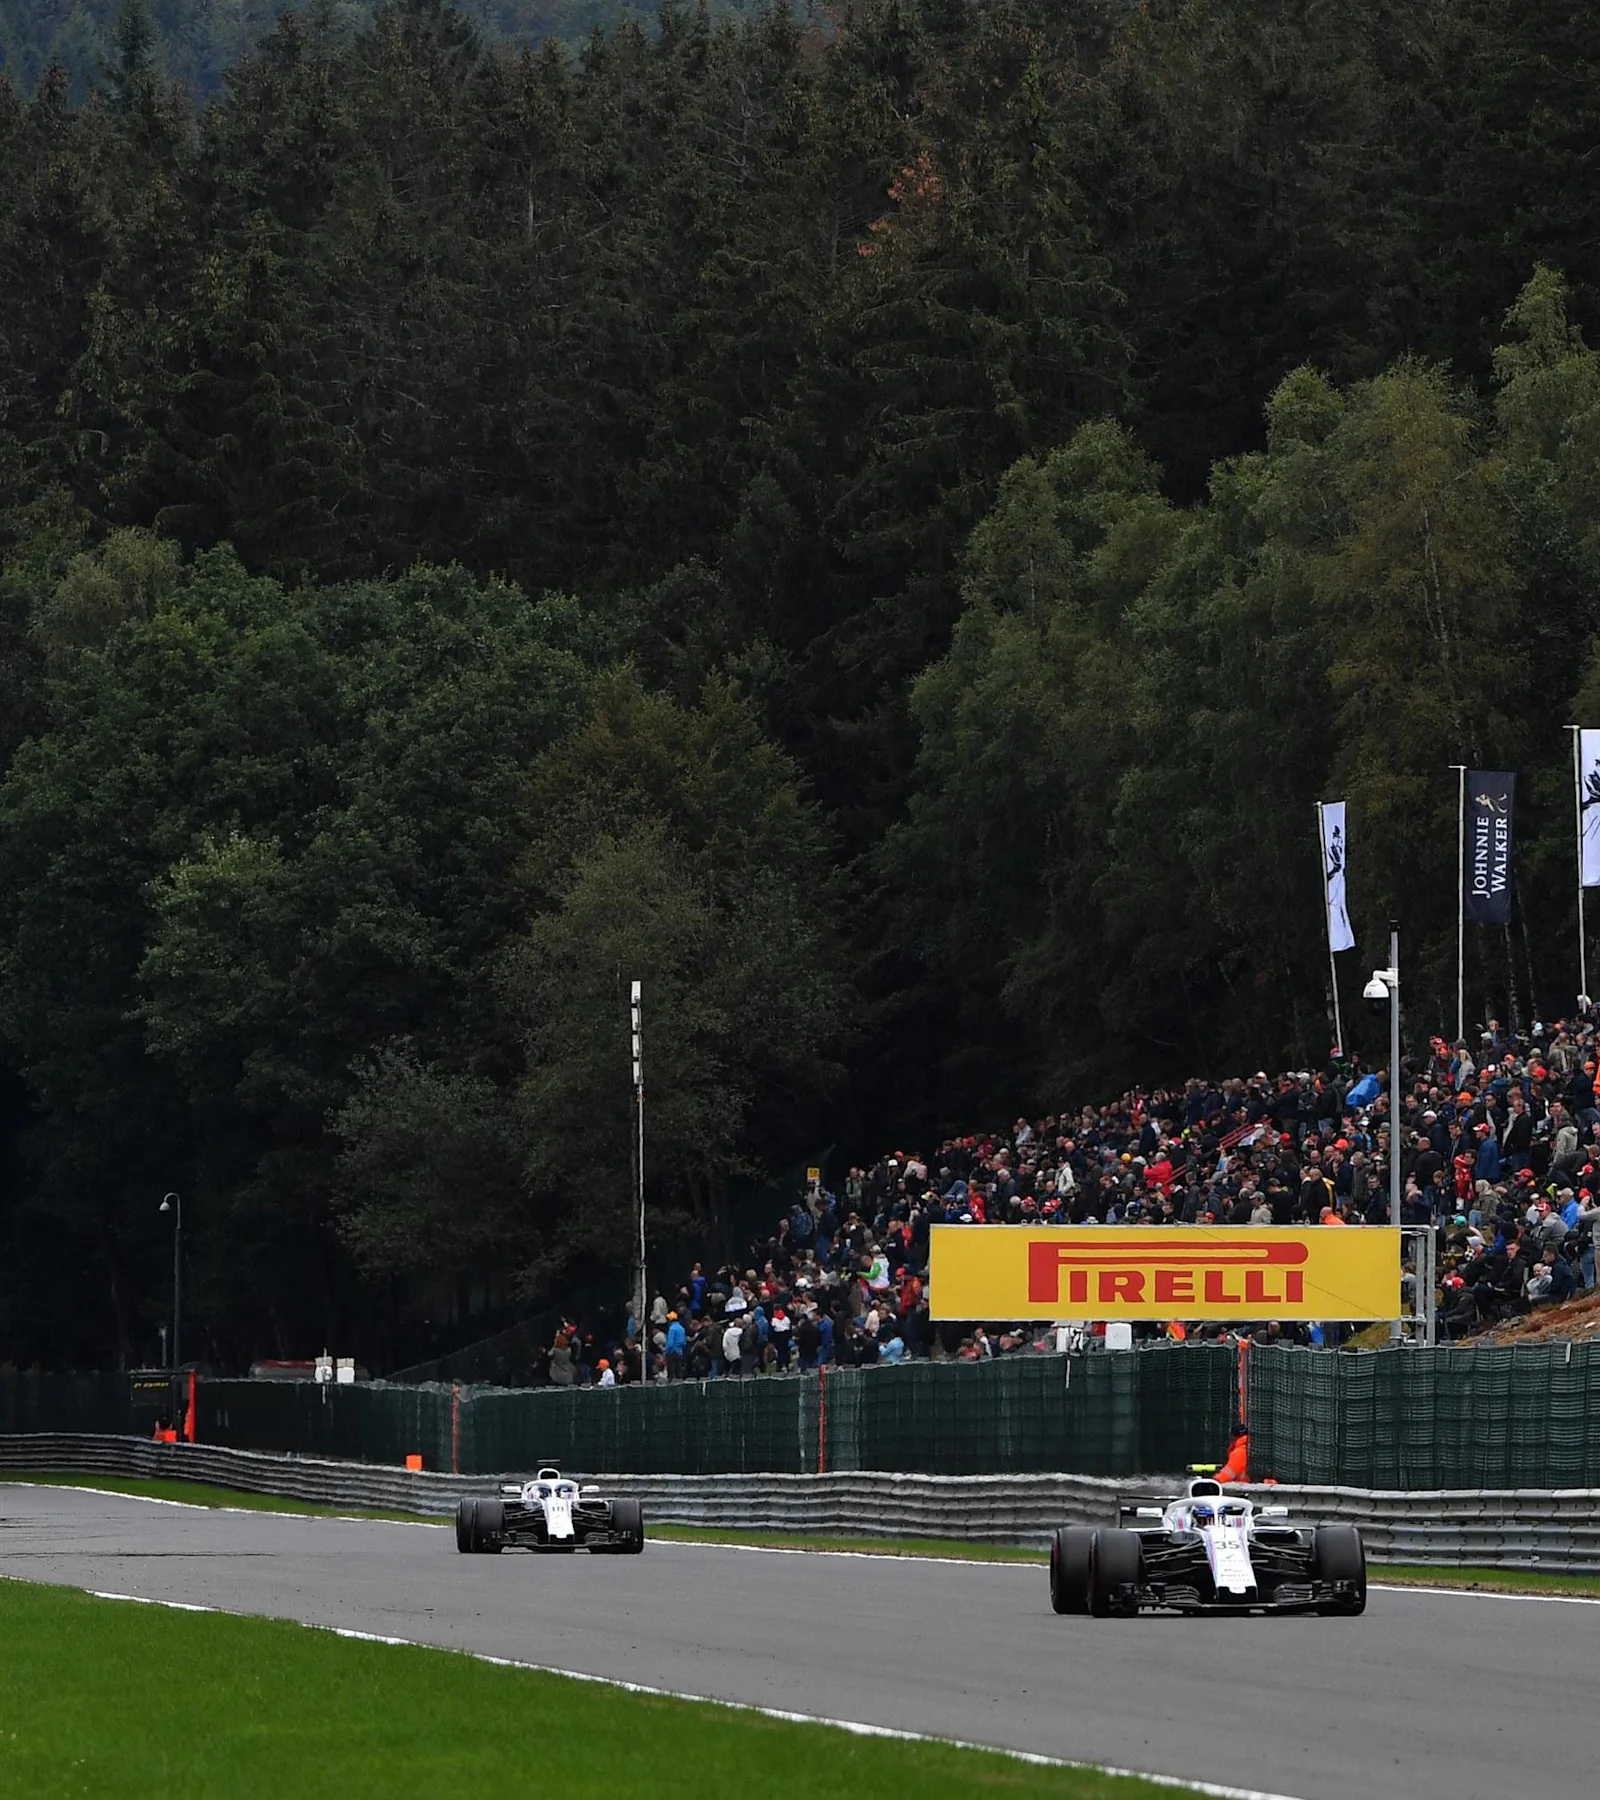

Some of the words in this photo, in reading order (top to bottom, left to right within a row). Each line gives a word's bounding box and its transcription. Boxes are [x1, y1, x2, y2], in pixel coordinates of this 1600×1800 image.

[1472, 816, 1491, 899] JOHNNIE
[1490, 817, 1508, 893] WALKER
[1028, 1241, 1309, 1303] PIRELLI
[1215, 1540, 1240, 1550] 35
